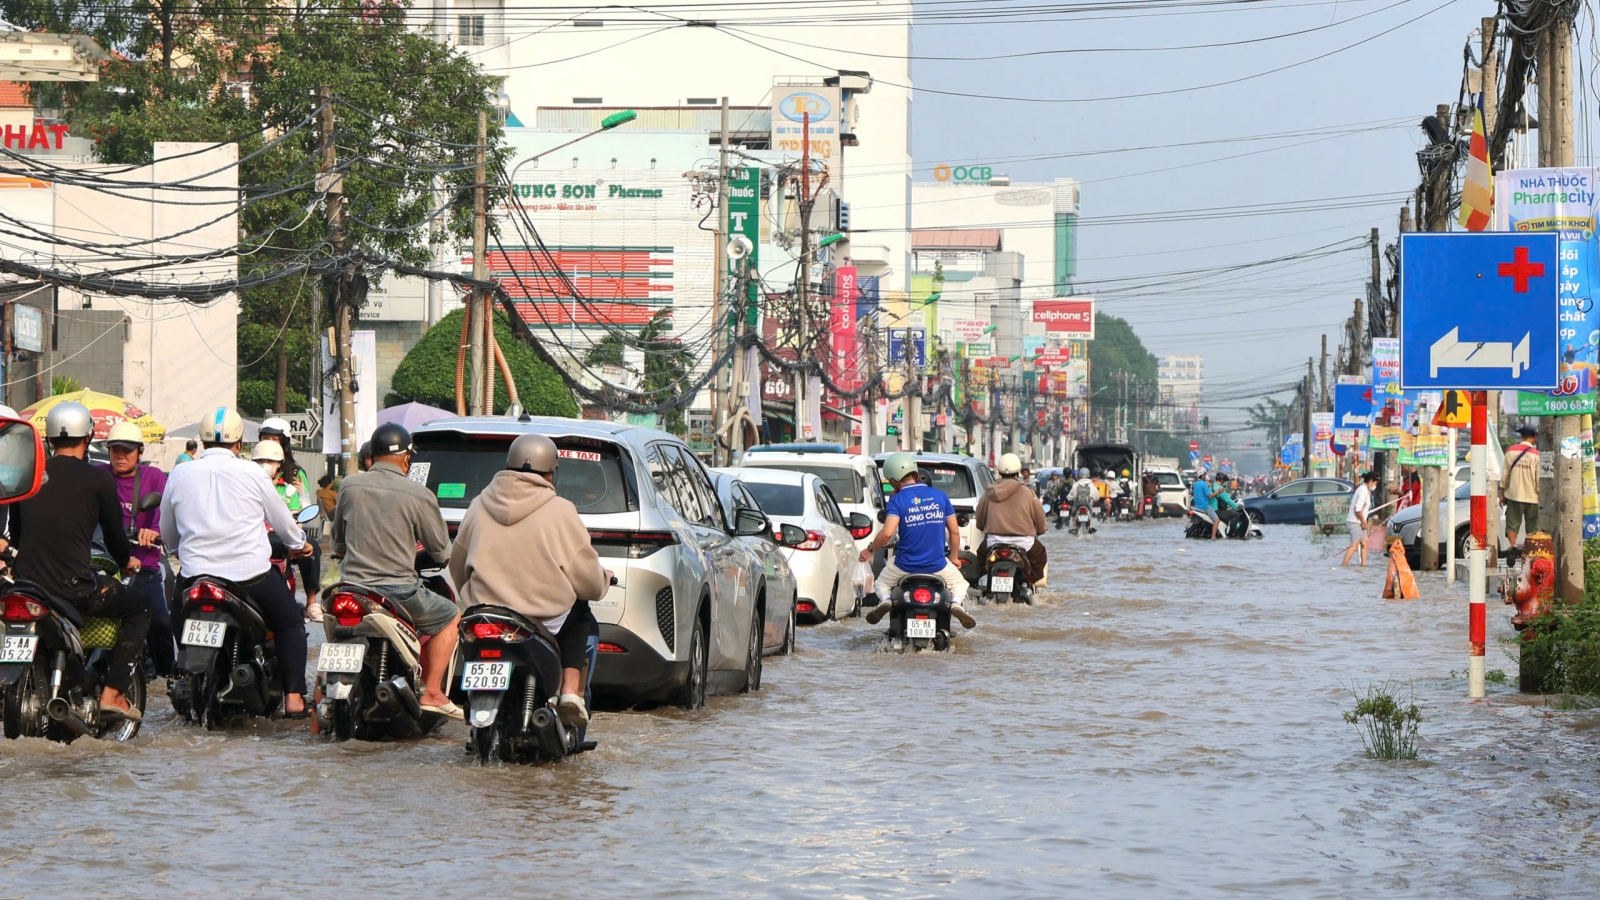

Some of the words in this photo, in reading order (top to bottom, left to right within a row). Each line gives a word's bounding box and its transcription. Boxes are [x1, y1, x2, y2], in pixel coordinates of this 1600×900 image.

[0, 118, 70, 149] HÁT
[953, 166, 992, 181] OCB
[1520, 176, 1545, 188] NHÀ
[1547, 174, 1588, 187] THUỐC
[511, 184, 557, 199] RUNG
[608, 184, 663, 199] Pharma
[1513, 188, 1595, 206] Pharmacity
[1531, 221, 1545, 229] TIM
[1566, 232, 1581, 240] VUI
[1562, 265, 1579, 278] áp
[1560, 281, 1581, 293] gày
[1560, 298, 1585, 309] ung
[360, 311, 381, 319] ervice
[1560, 327, 1576, 339] ợp
[1375, 359, 1399, 368] HÀNG
[1544, 401, 1568, 411] 1800
[1570, 400, 1594, 411] 6821
[559, 450, 572, 458] XE
[576, 451, 599, 461] TAXI
[904, 513, 924, 524] LONG
[925, 510, 944, 520] CHÂU
[190, 621, 220, 633] 64-V2
[5, 637, 30, 649] 5-AA
[187, 632, 217, 644] 0446
[327, 645, 357, 658] 65-B1
[320, 658, 360, 670] 285.59
[464, 676, 507, 688] 520.99
